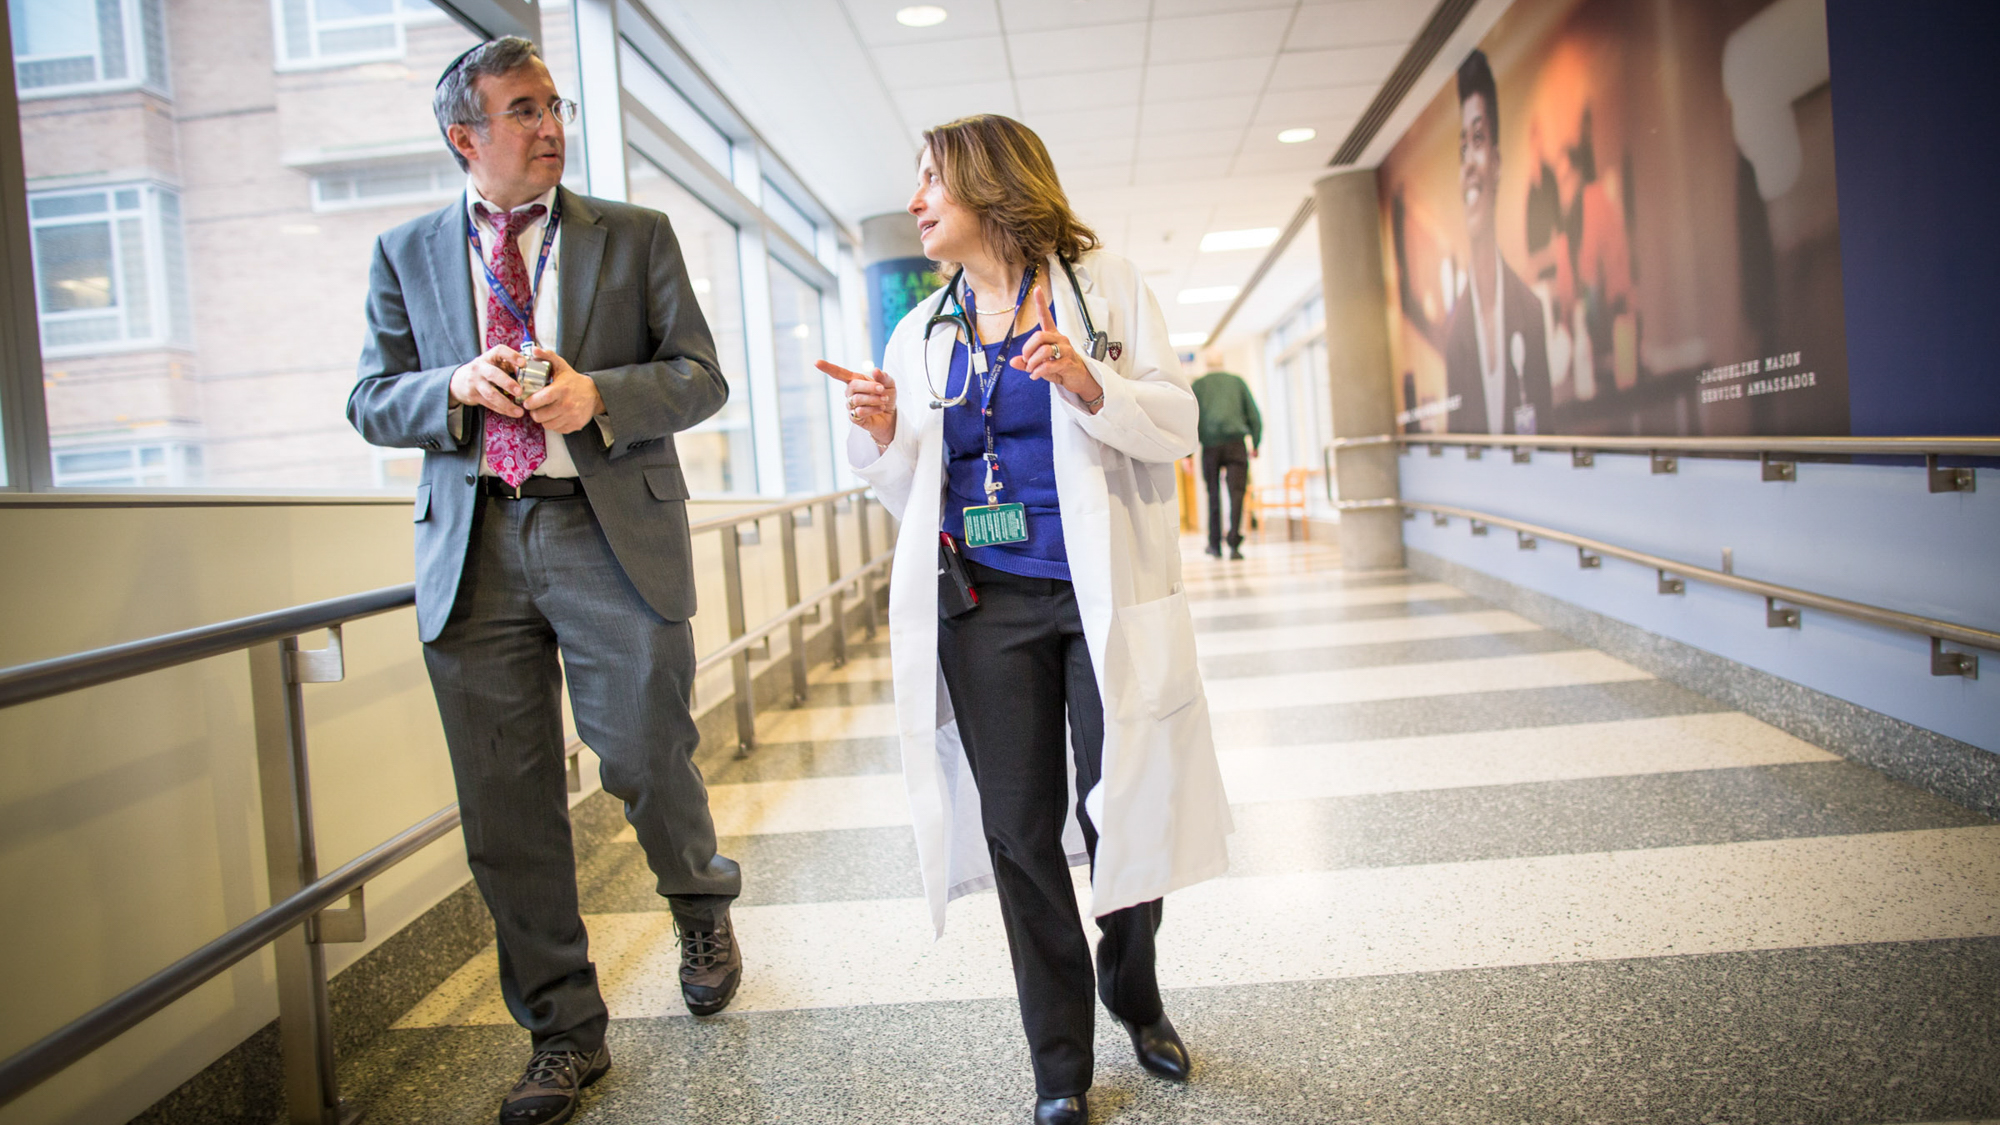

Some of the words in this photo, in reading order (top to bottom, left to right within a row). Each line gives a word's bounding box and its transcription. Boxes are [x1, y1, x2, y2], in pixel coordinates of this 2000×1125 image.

[1765, 351, 1801, 372] MASON
[1701, 384, 1742, 403] SERVICE
[1747, 371, 1816, 396] AMBASSADOR
